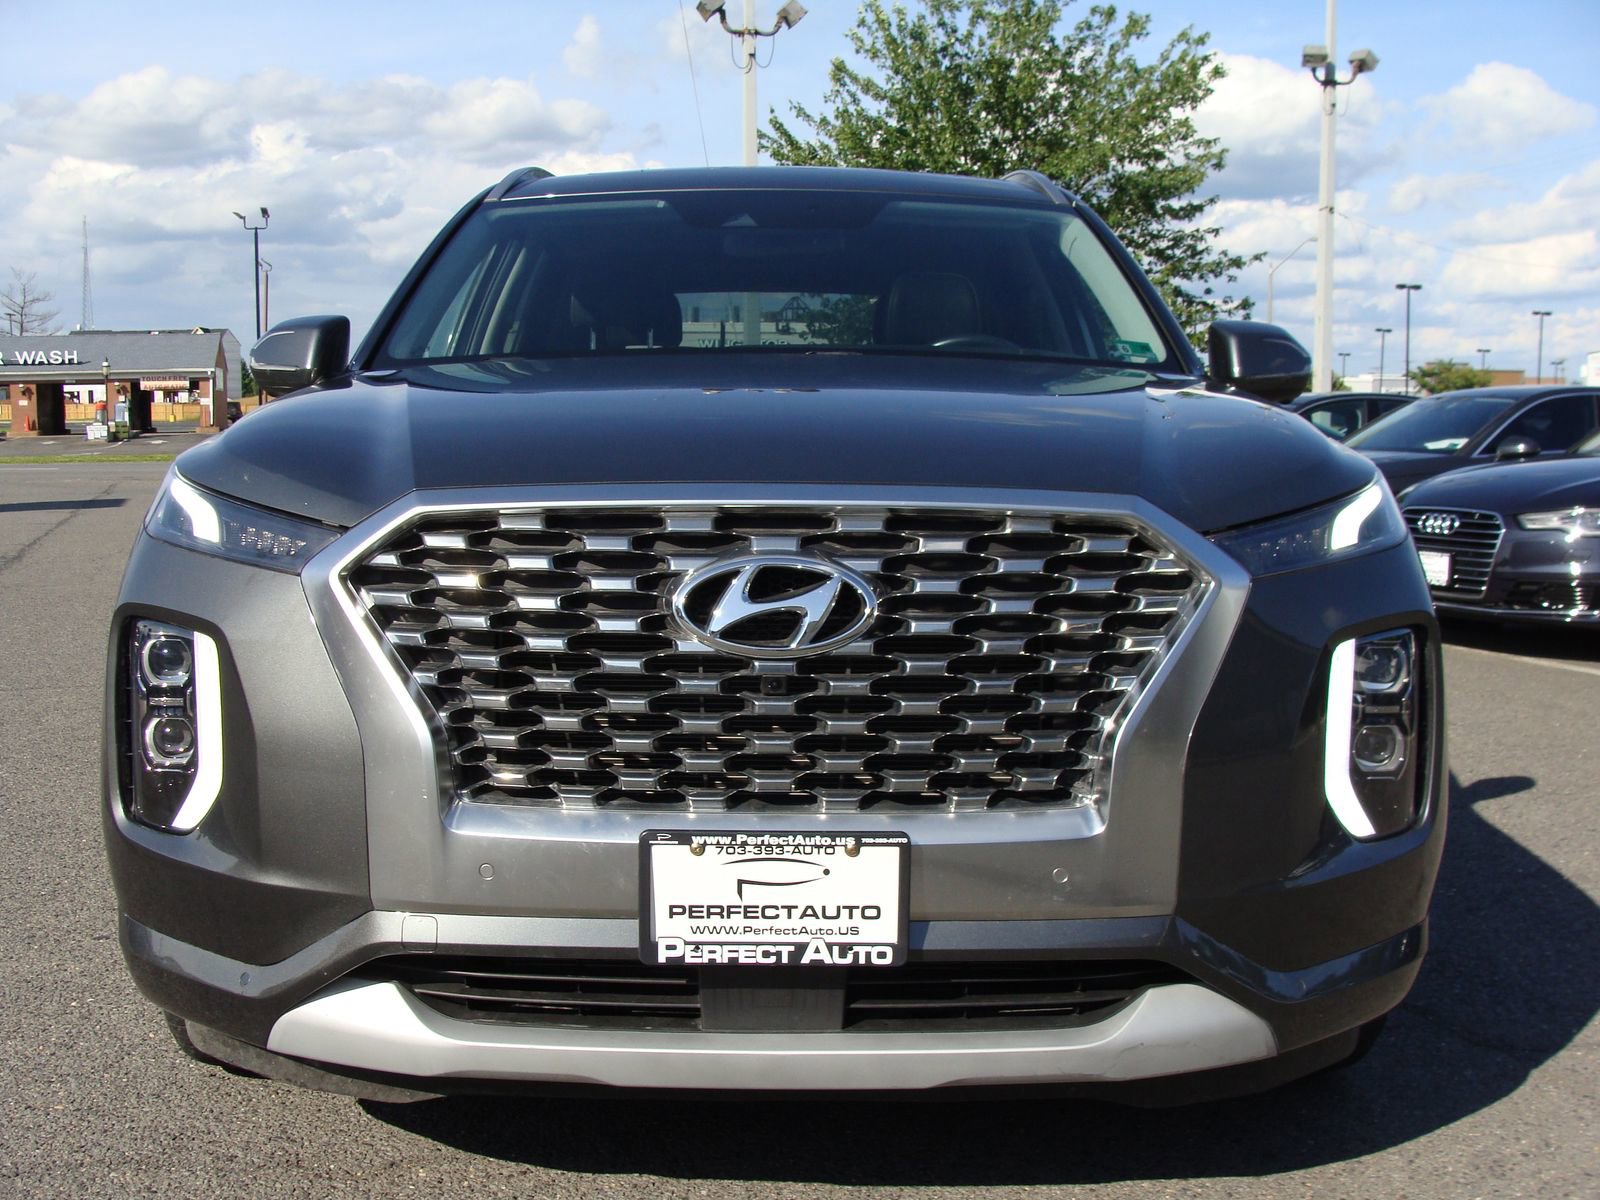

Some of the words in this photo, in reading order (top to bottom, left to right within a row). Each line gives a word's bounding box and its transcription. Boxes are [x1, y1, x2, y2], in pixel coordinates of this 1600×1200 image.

[15, 350, 78, 364] WASH
[691, 834, 856, 846] www.PerfectAuto.us
[715, 845, 836, 855] 703-393-AUTO
[668, 904, 881, 920] PERFECTAUTO
[690, 925, 860, 936] WWW.PerfectAuto.US
[658, 937, 795, 964] PERFECT
[801, 937, 894, 965] AUTO
